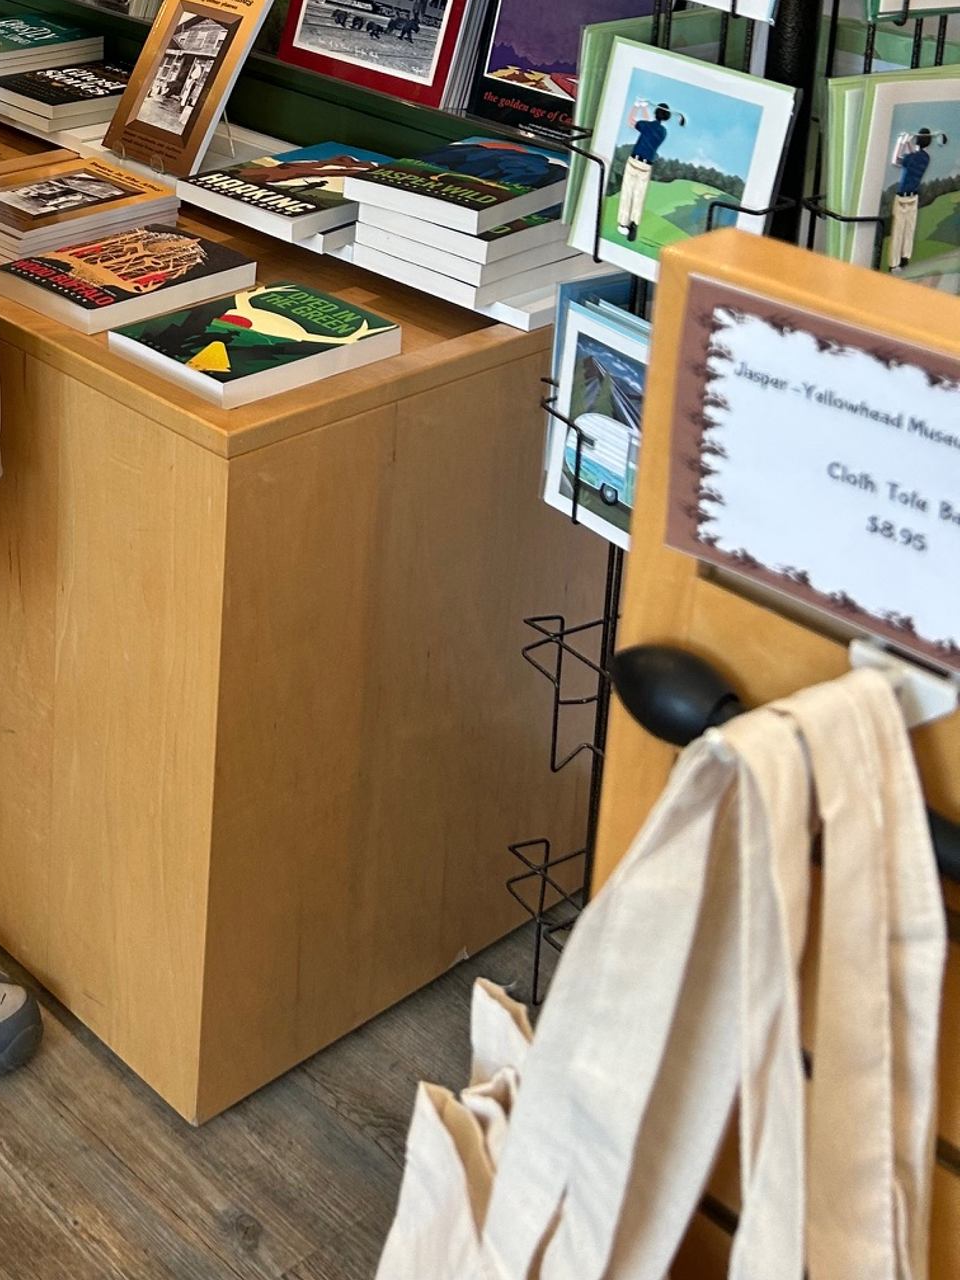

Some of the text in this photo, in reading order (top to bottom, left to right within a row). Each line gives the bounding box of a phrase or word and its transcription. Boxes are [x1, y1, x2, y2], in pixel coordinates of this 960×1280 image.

[483, 91, 558, 122] the golden age of
[367, 169, 443, 190] JASPER
[441, 184, 498, 204] WILD
[261, 293, 357, 334] THE GREEN
[287, 292, 362, 323] DYED IN
[734, 361, 788, 390] Jasper
[907, 416, 960, 450] Museu
[826, 461, 929, 512] Cloth Tote
[865, 515, 928, 552] $8.95
